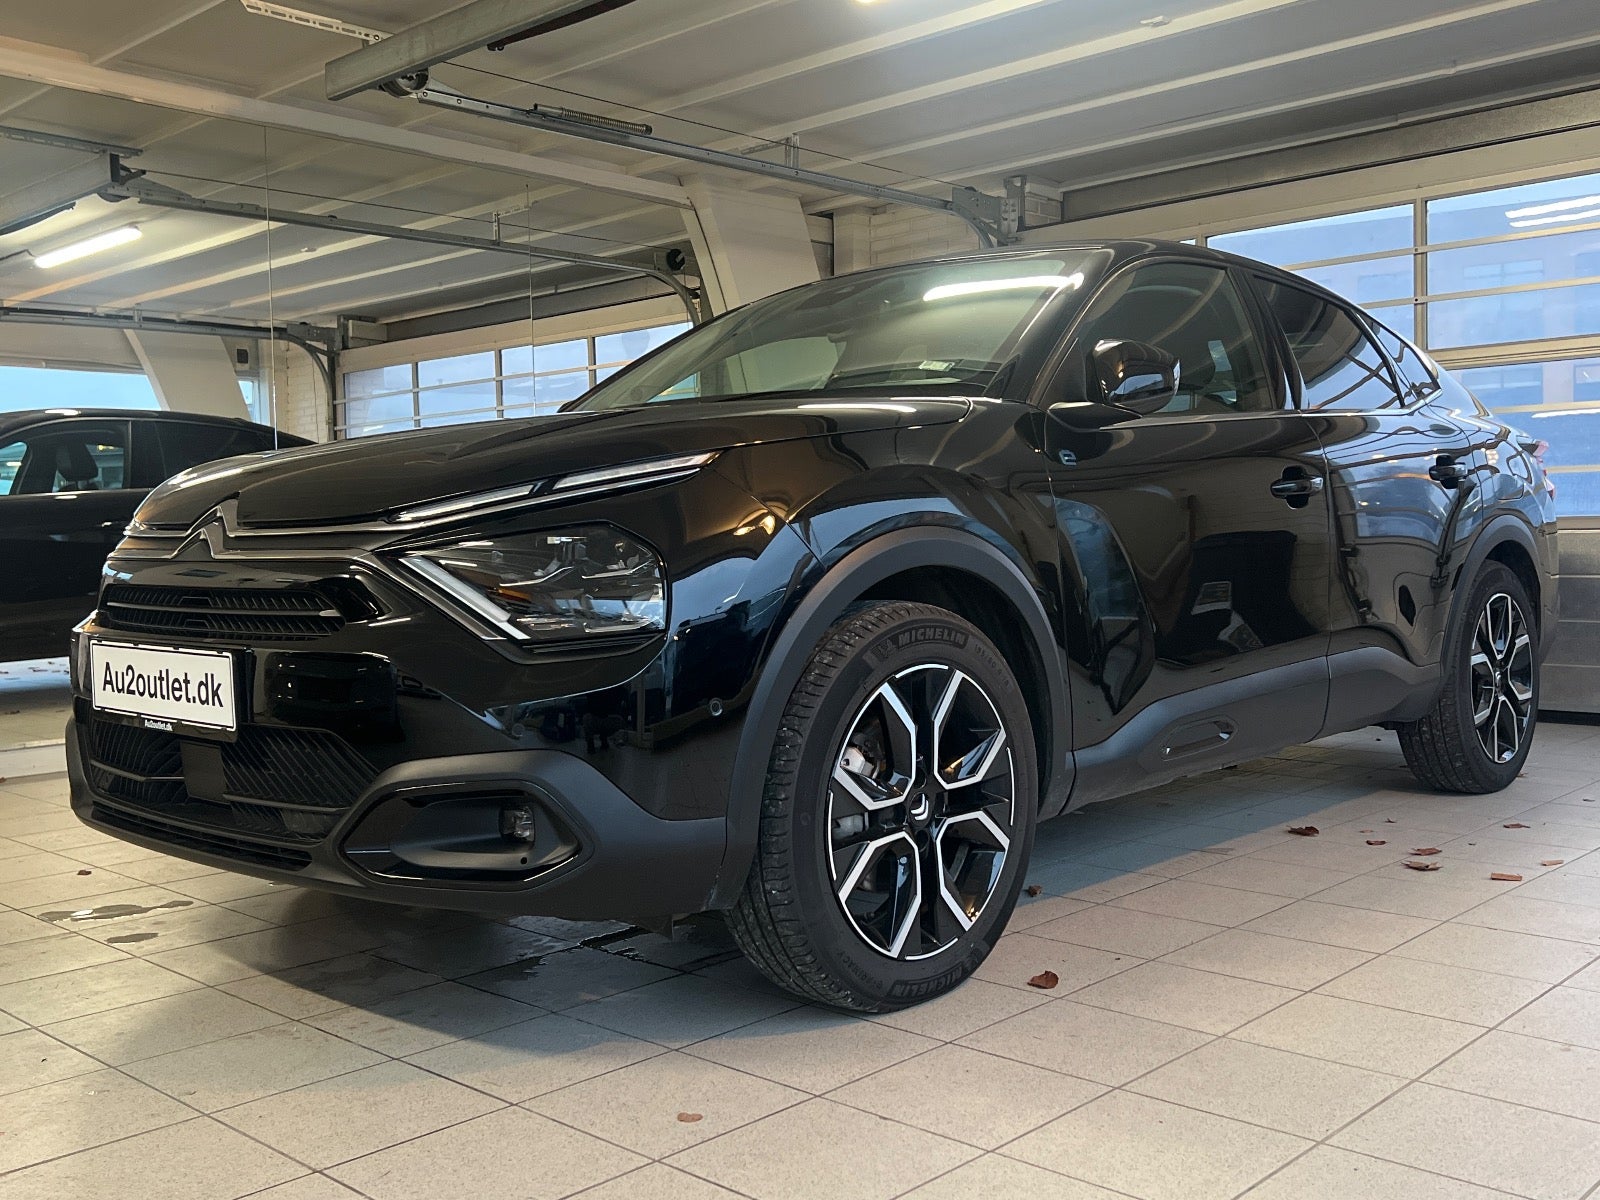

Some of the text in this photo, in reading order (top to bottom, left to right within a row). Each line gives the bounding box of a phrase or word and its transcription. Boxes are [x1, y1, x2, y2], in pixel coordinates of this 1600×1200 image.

[898, 627, 966, 647] MICHELIN
[103, 661, 224, 708] Au2outlet.dk
[893, 966, 963, 997] MICHELIN
